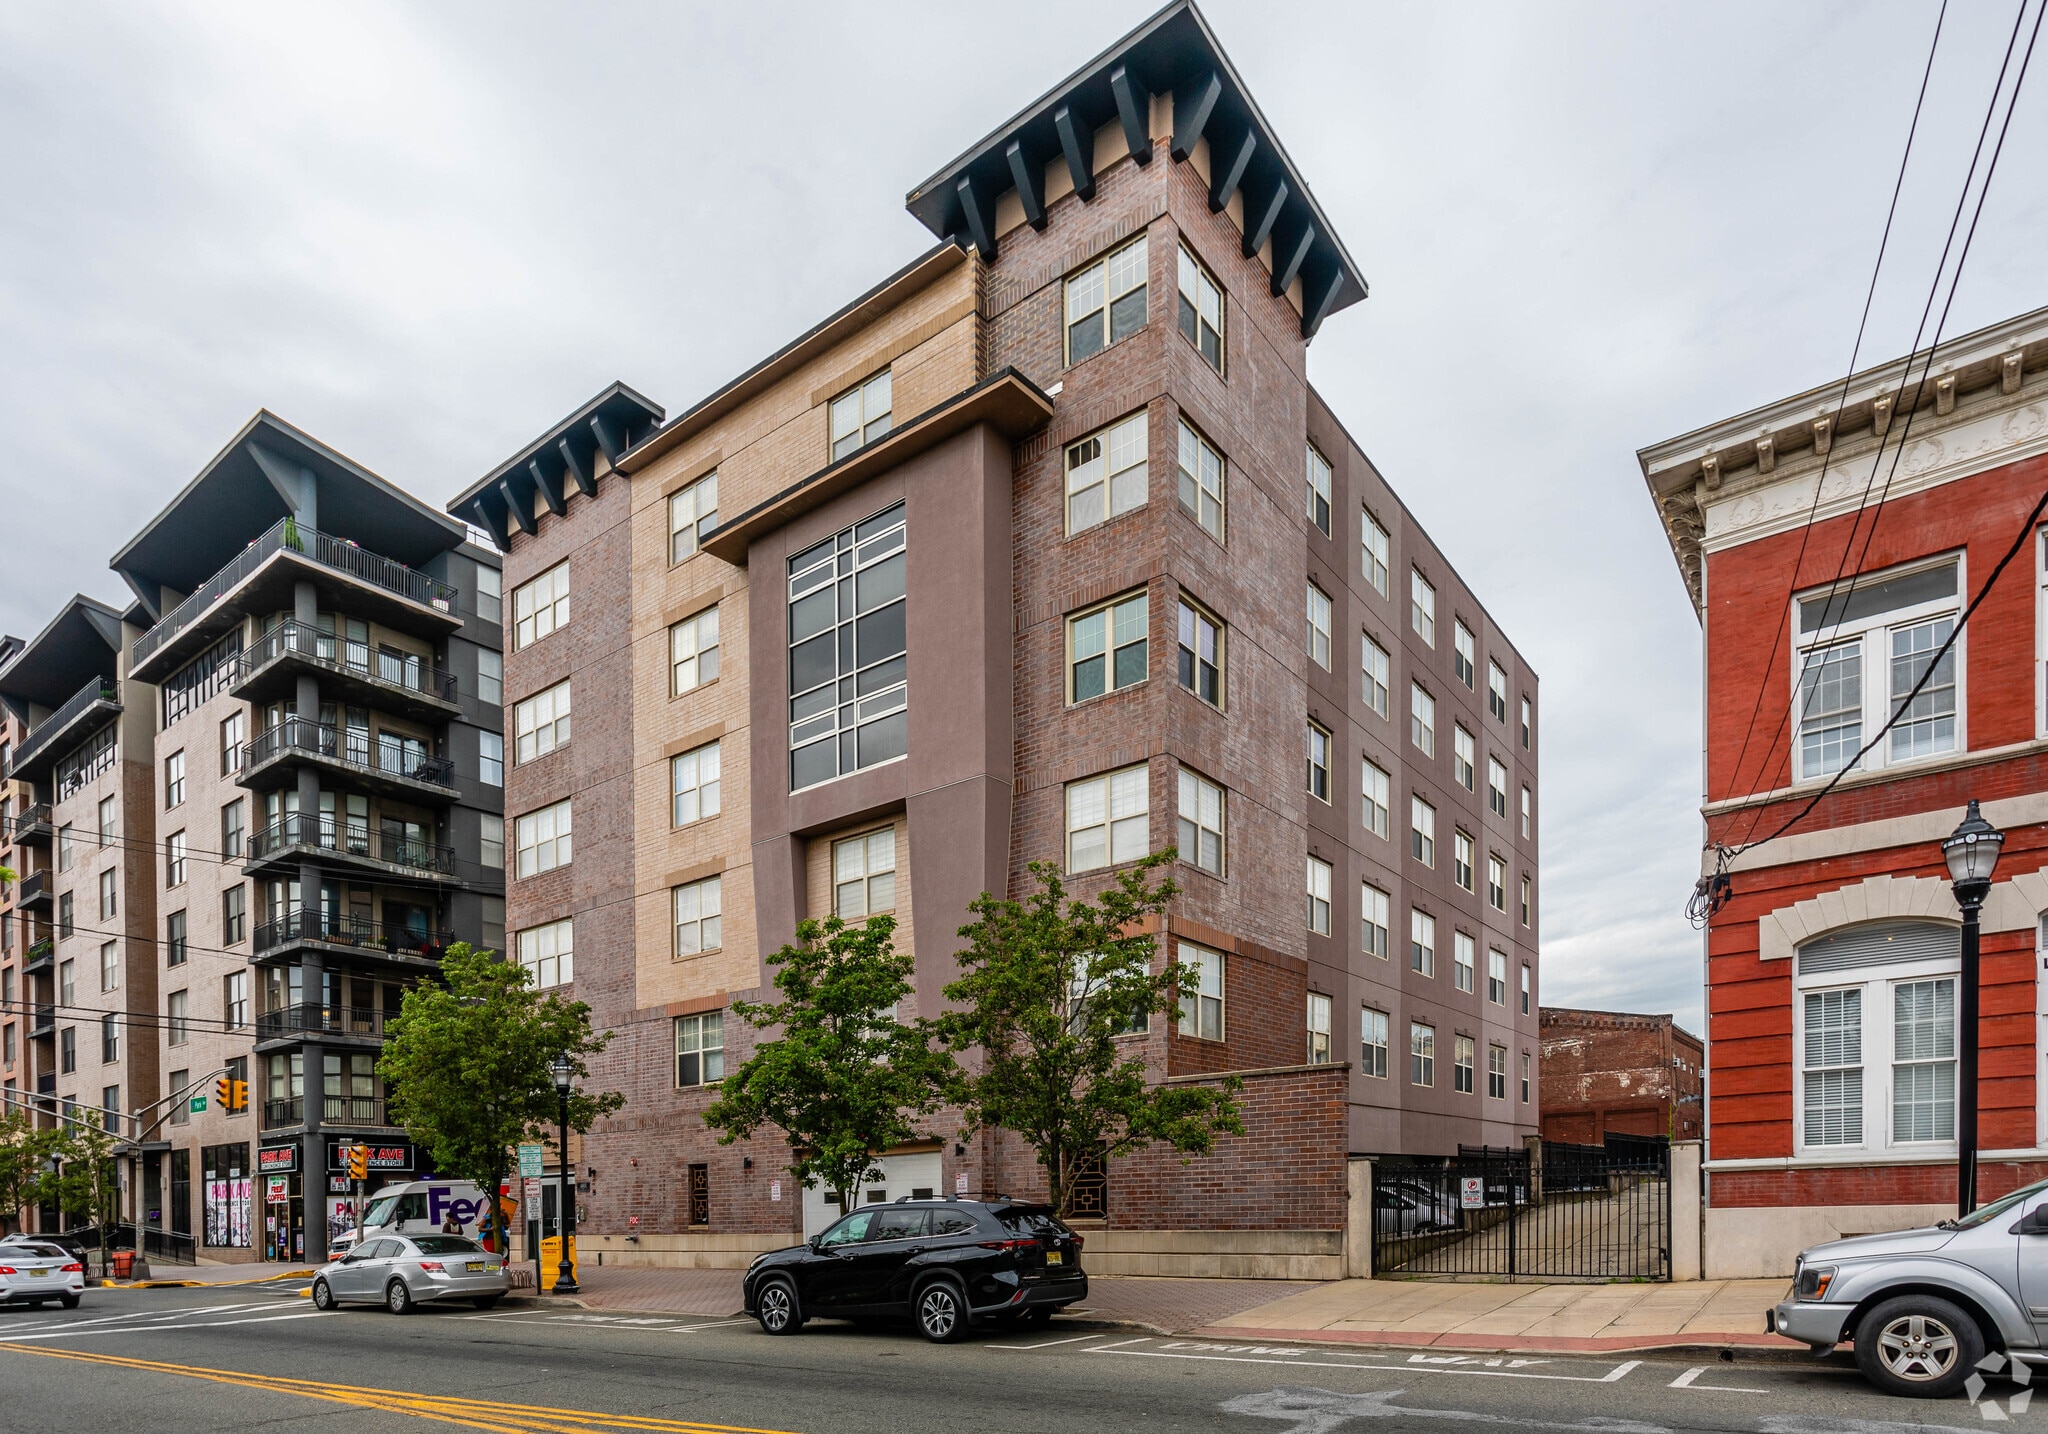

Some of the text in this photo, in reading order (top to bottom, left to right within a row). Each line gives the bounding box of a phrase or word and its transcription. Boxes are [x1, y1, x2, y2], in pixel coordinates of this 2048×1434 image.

[260, 1149, 292, 1164] PARK AVE
[378, 1148, 404, 1160] AVE
[211, 1182, 252, 1199] PARK AVE
[630, 1216, 639, 1224] FDC
